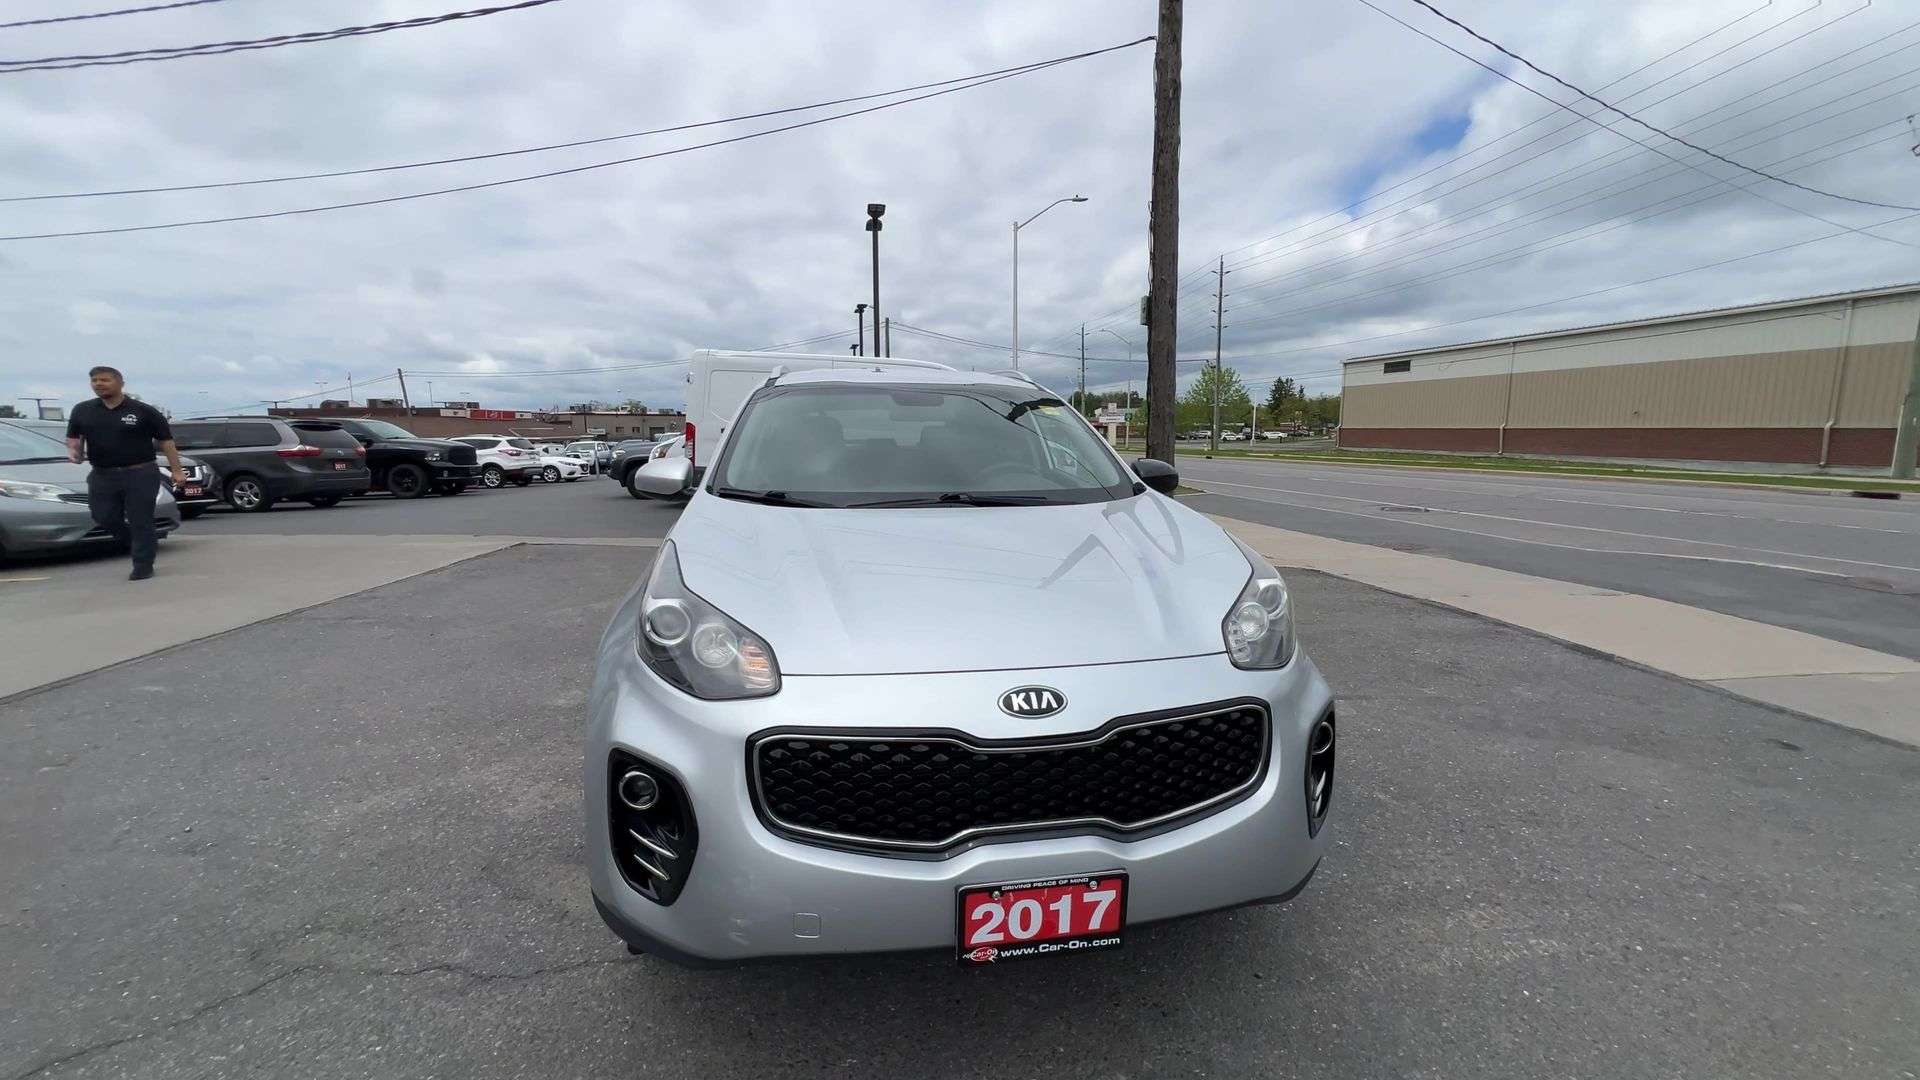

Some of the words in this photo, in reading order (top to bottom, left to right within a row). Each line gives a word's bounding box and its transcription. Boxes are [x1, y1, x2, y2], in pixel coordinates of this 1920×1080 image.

[1010, 691, 1058, 711] KIA
[1001, 883, 1031, 891] DRIVING
[1033, 880, 1057, 888] PEACE
[970, 890, 1117, 945] 2017
[1000, 937, 1121, 957] www.Car-On.com
